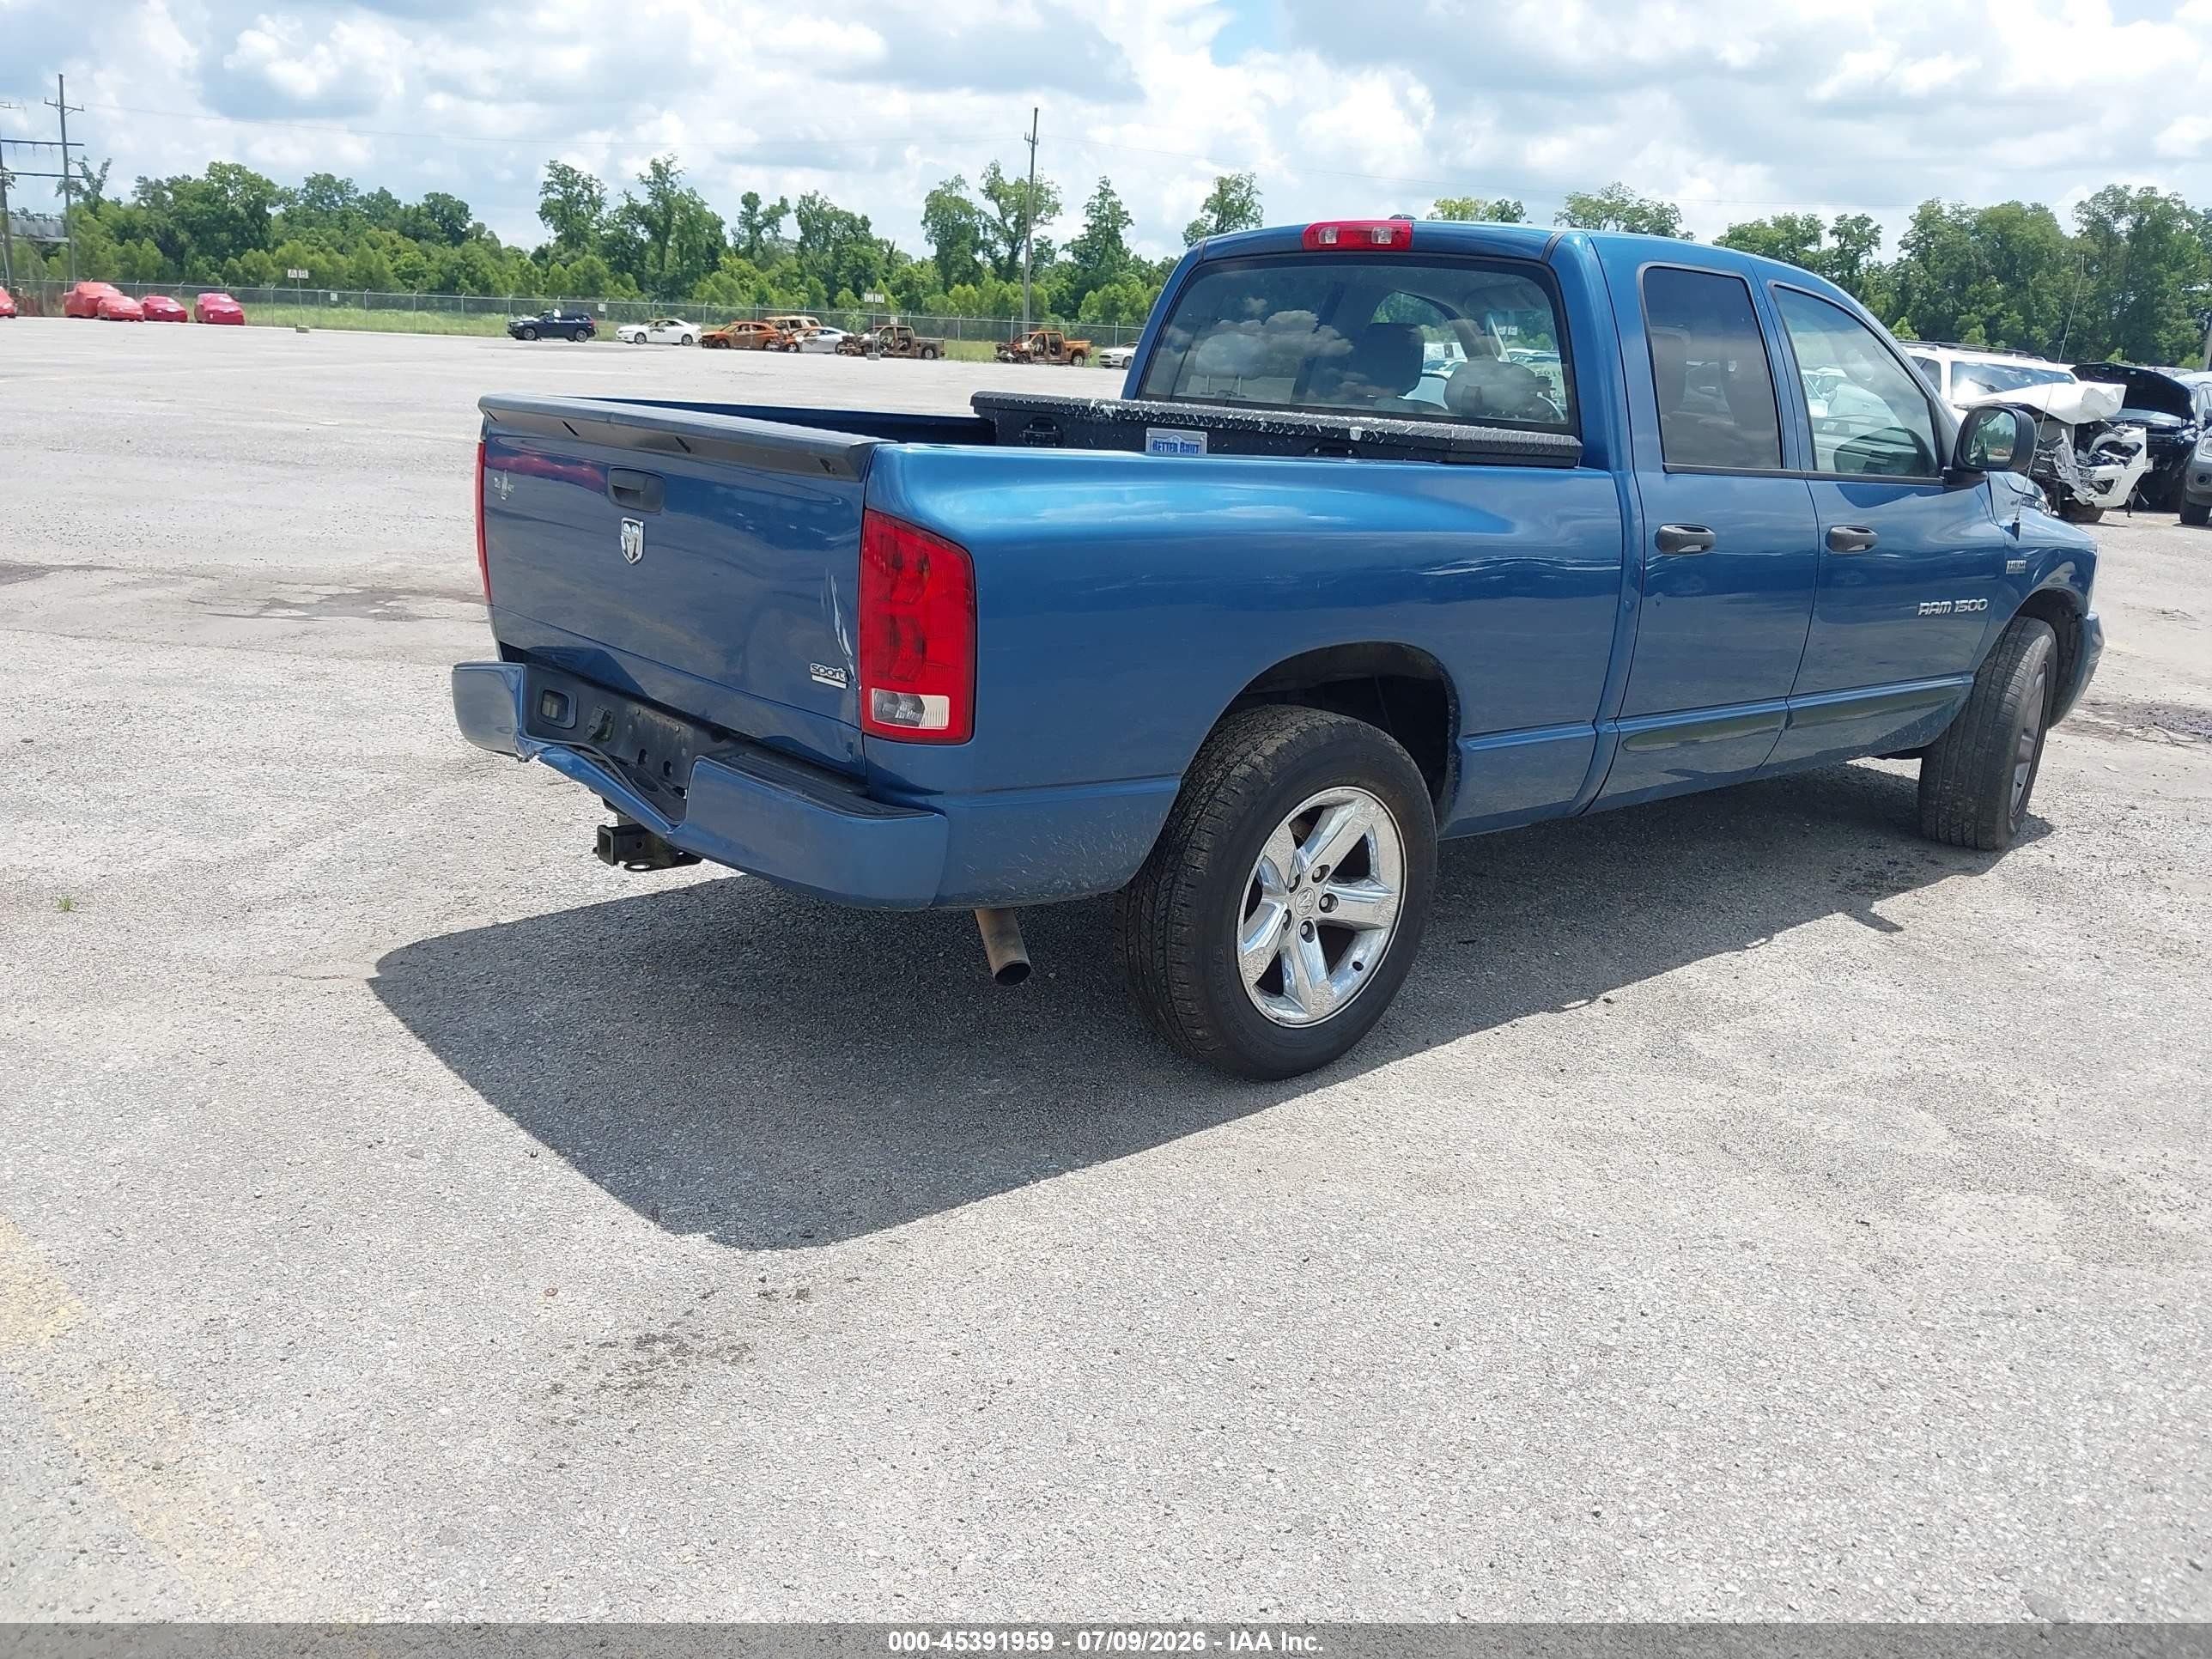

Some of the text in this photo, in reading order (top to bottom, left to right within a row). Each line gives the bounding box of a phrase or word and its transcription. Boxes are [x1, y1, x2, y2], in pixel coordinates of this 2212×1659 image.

[1152, 440, 1178, 453] BETTER
[1917, 599, 1988, 616] RAM 1500
[810, 662, 847, 683] sport
